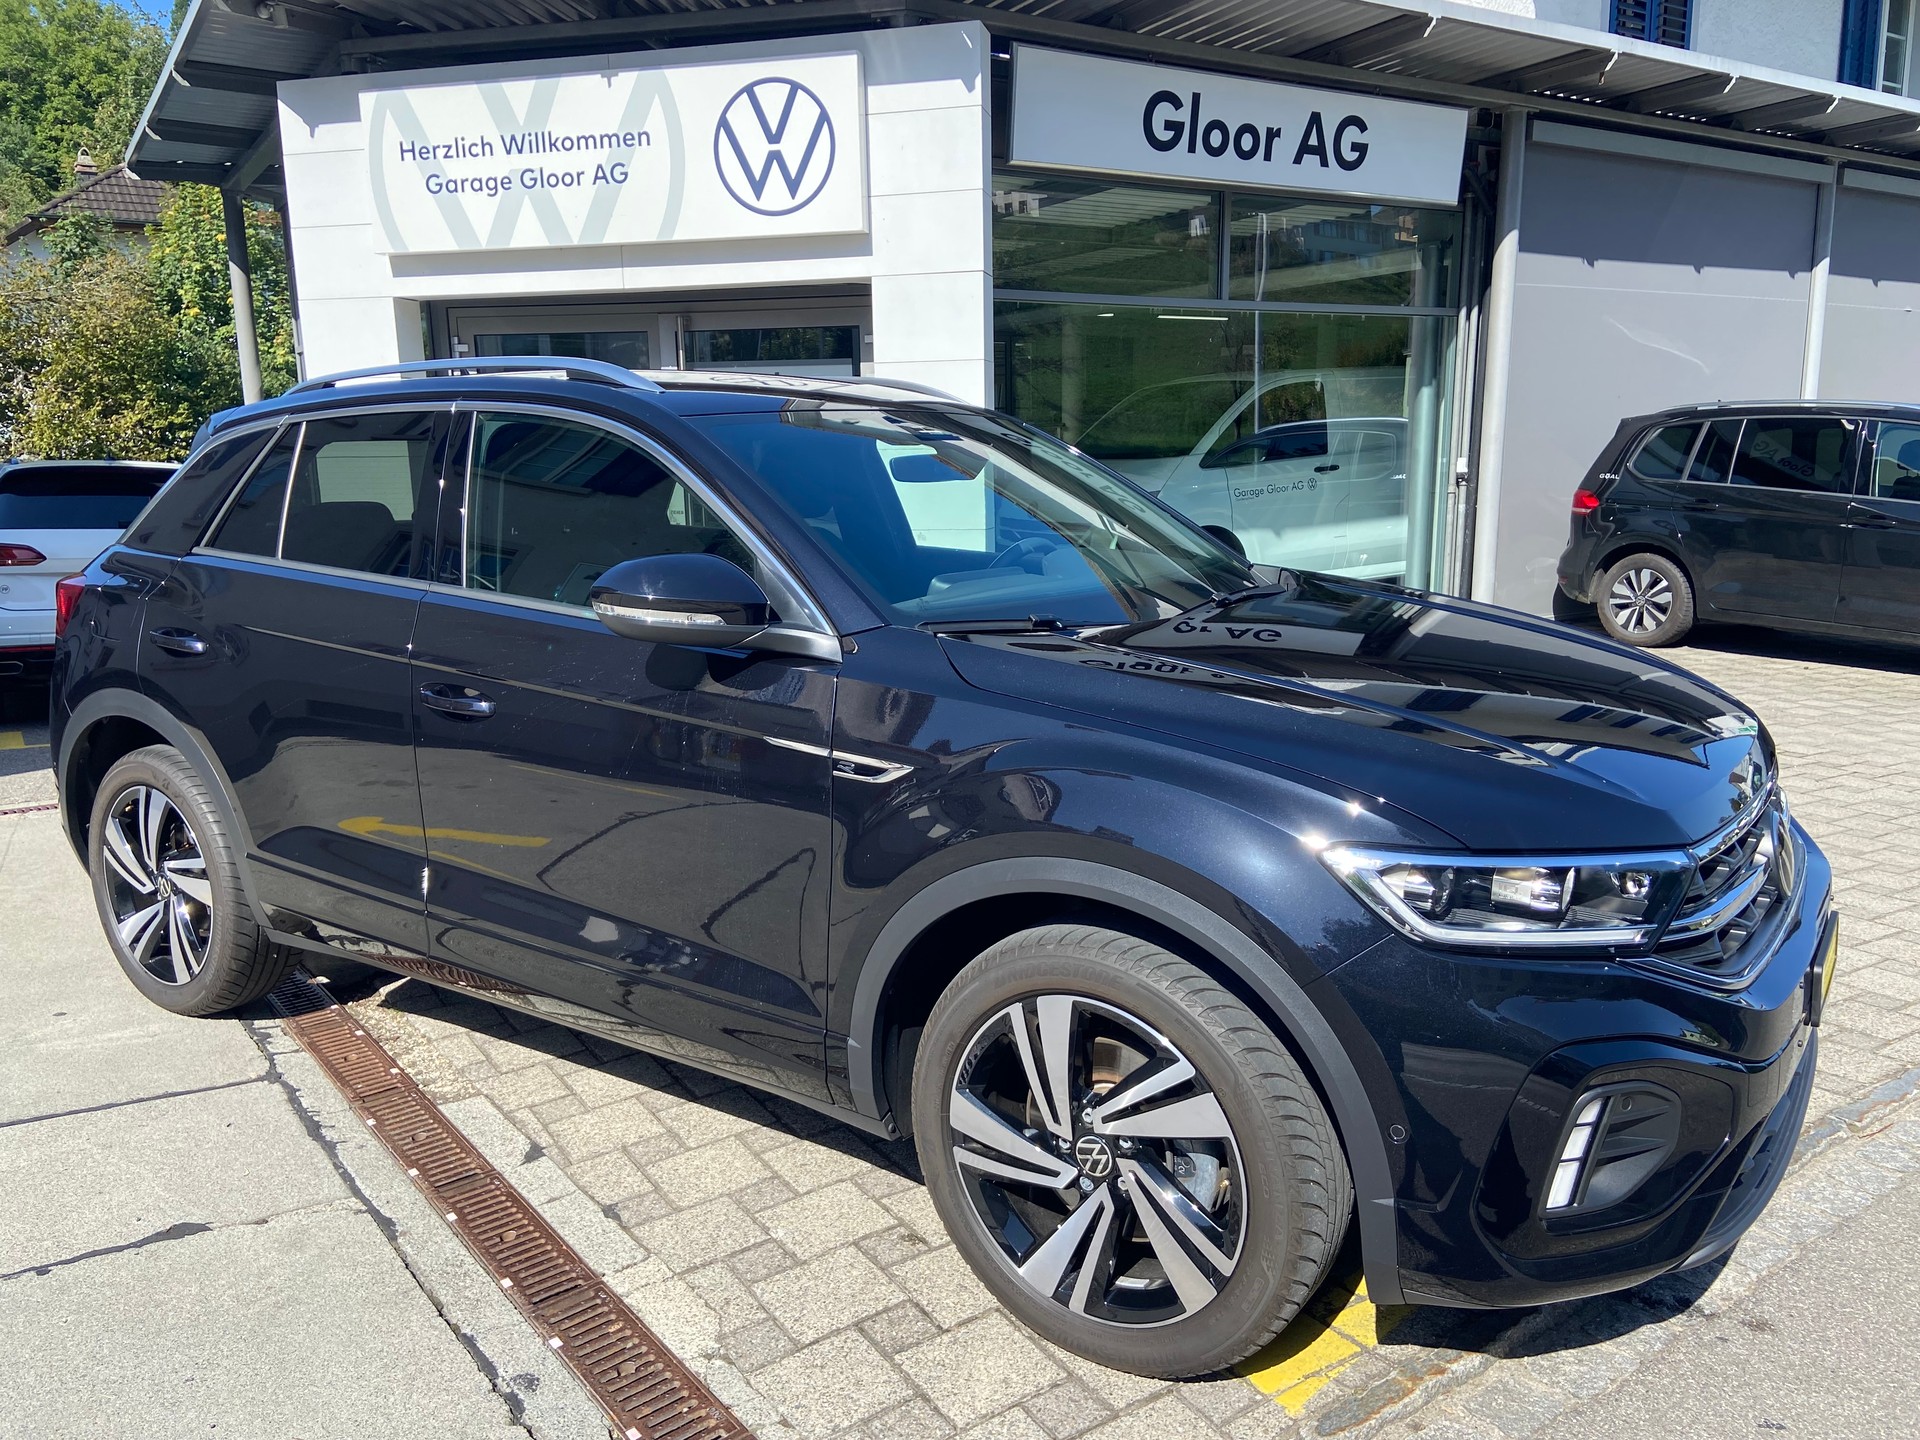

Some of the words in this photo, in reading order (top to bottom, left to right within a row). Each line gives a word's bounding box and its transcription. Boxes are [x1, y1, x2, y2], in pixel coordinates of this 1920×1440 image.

[398, 134, 495, 162] Herzlich
[500, 130, 652, 156] Willkommen
[1143, 89, 1282, 162] Gloor
[1292, 110, 1370, 172] AG
[425, 172, 513, 198] Garage
[519, 167, 586, 191] Gloor
[592, 162, 629, 186] AG
[1233, 487, 1265, 498] Garage
[1266, 483, 1290, 494] Gloor
[1291, 480, 1305, 491] AG
